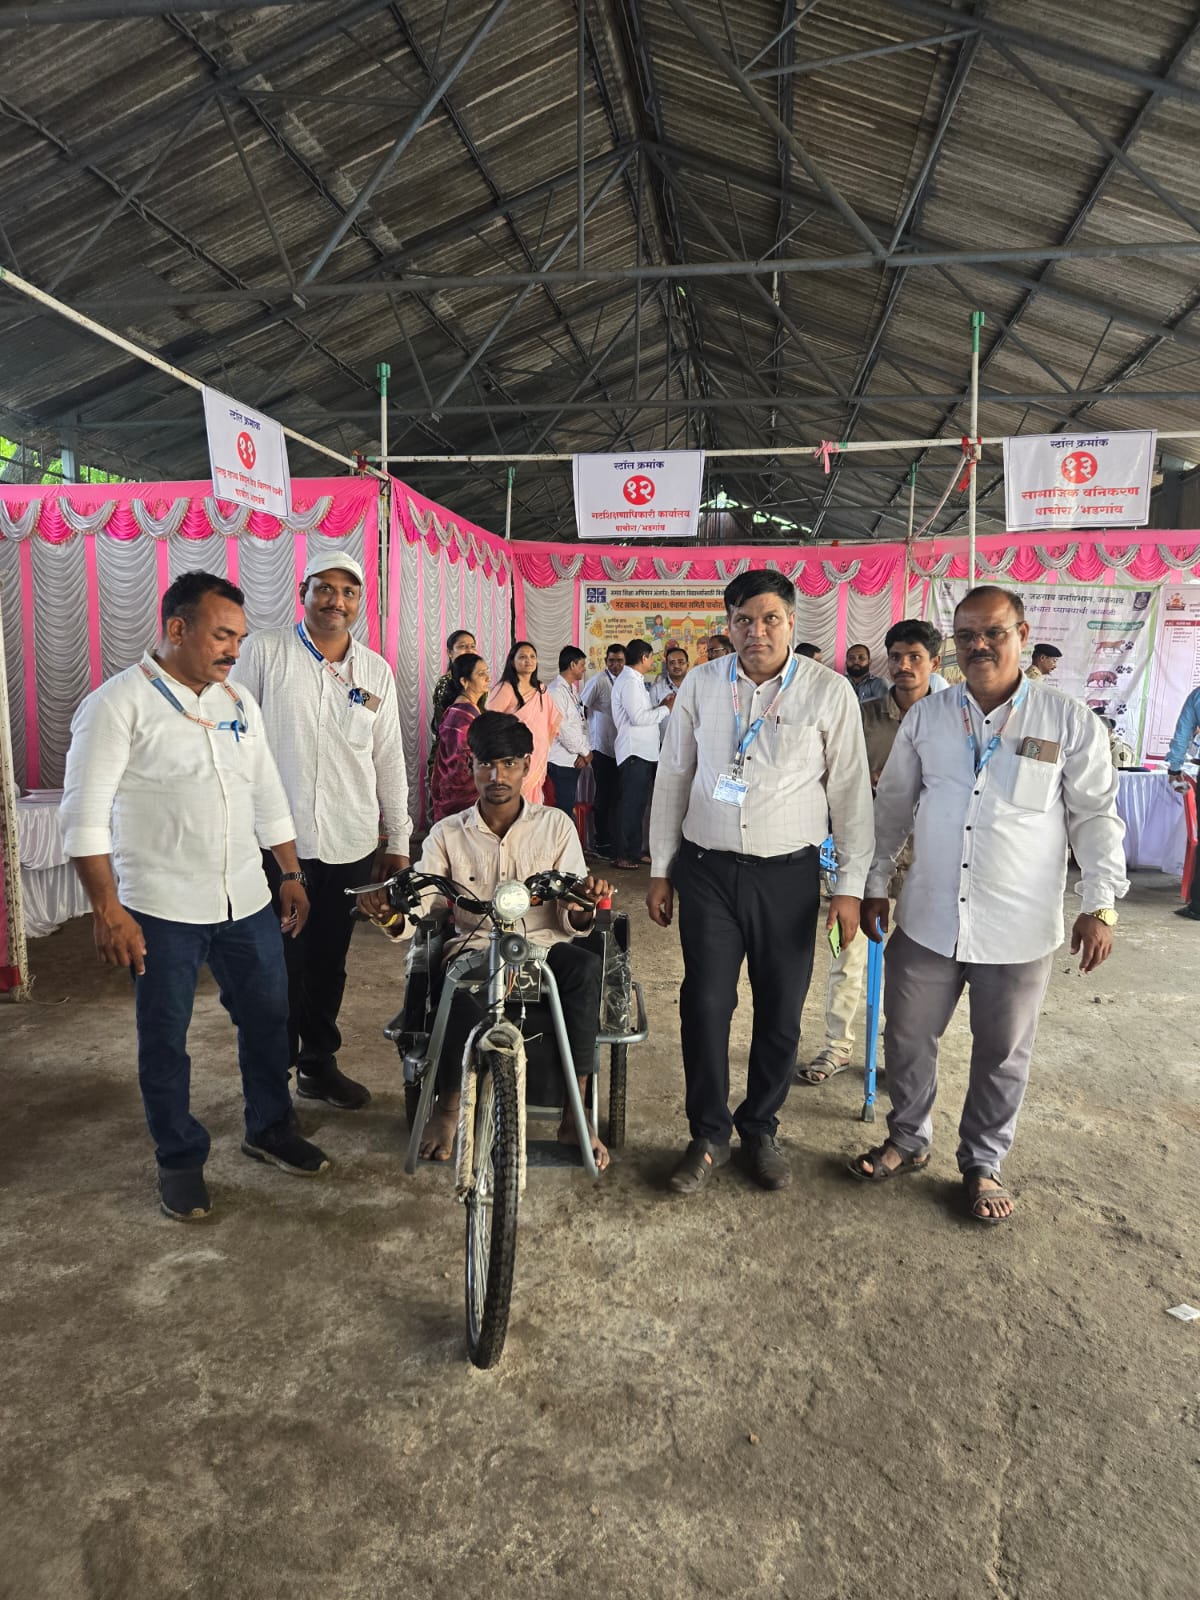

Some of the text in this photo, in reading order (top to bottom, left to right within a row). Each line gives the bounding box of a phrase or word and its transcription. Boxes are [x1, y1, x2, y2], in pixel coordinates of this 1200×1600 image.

[1050, 436, 1109, 448] स्टॉल क्रमांक
[613, 459, 665, 470] स्टॉल क्रमांक
[1065, 456, 1092, 478] १३
[627, 481, 653, 500] १२
[1021, 486, 1079, 500] सामाजिक
[591, 507, 691, 520] गटशिक्षणाधिकारी कार्यालय
